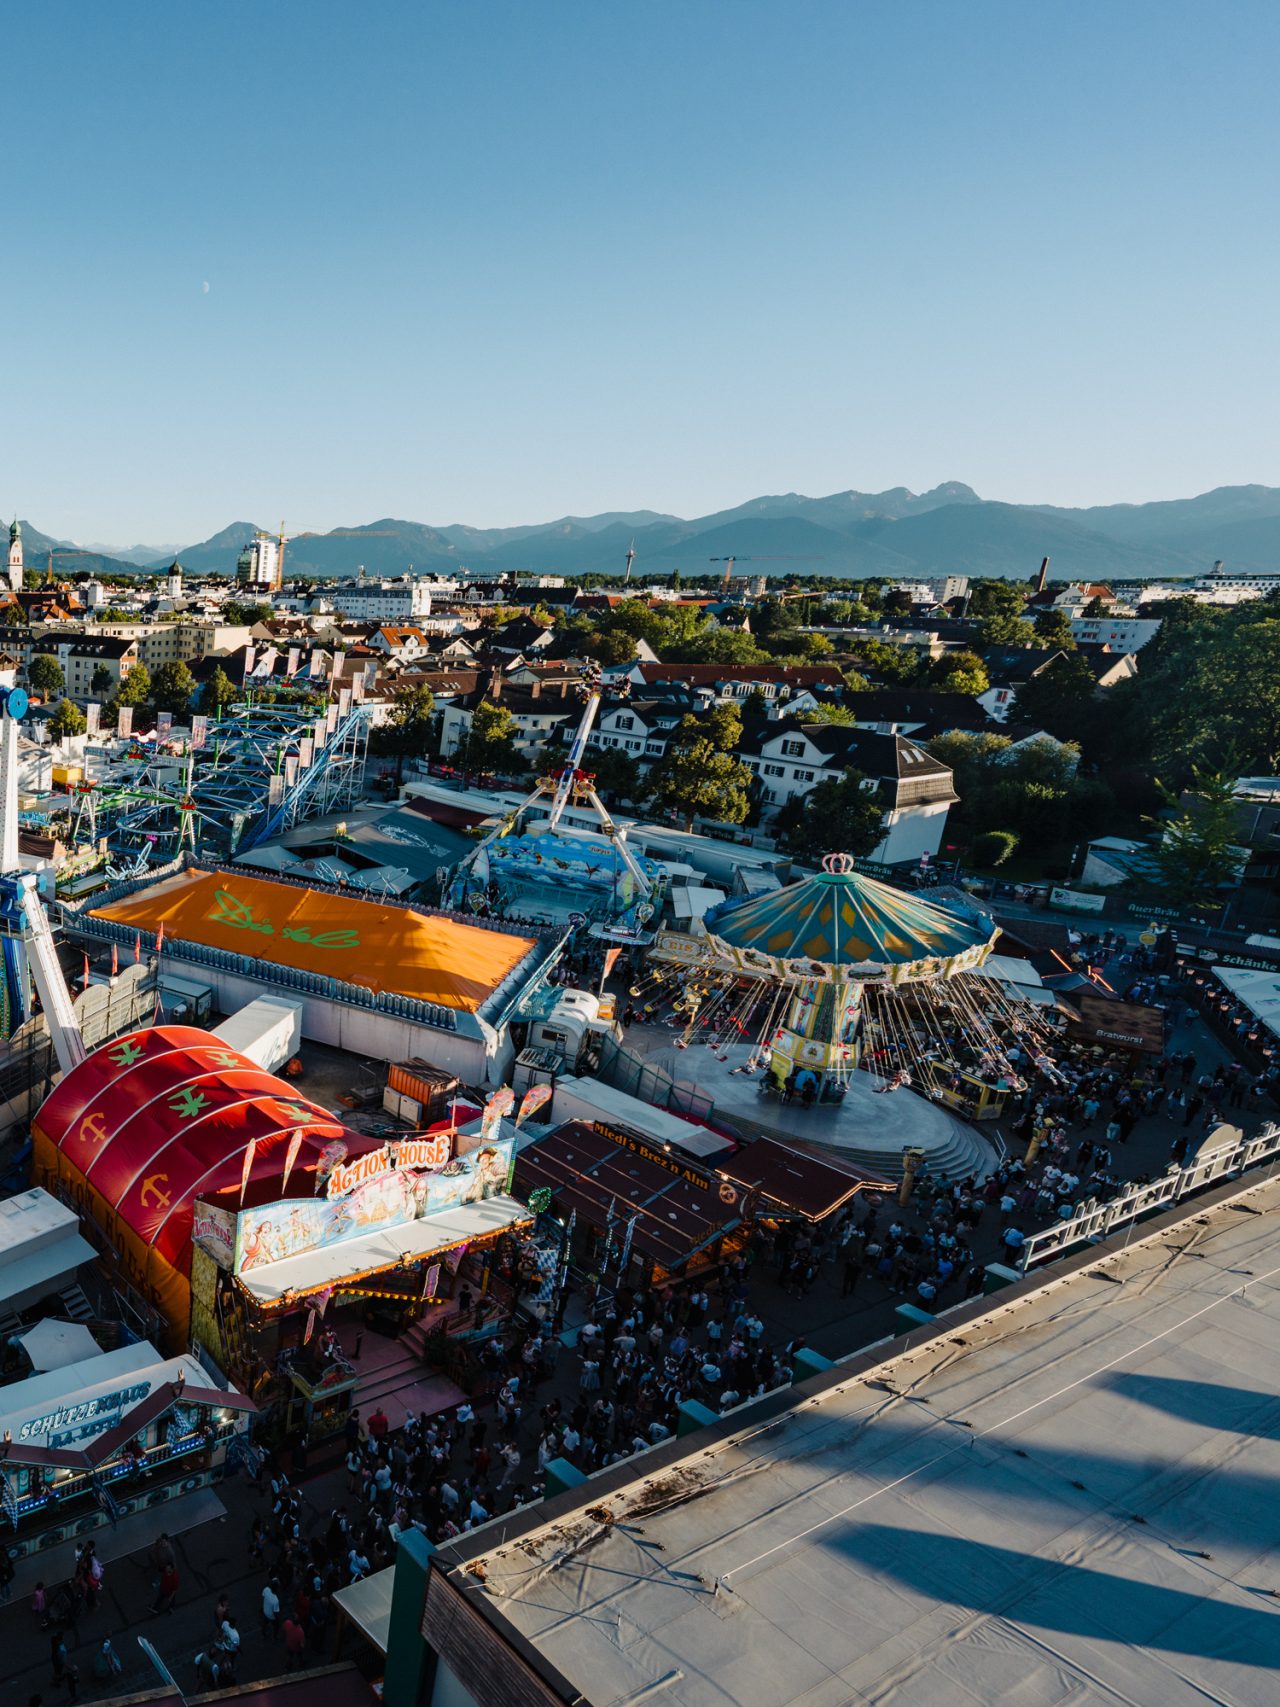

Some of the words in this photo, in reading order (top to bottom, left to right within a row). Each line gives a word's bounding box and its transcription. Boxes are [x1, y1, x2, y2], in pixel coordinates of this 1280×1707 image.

[1128, 903, 1180, 918] AuerBräu
[669, 941, 694, 953] EIS
[1222, 954, 1278, 972] Schänke
[1096, 1029, 1143, 1044] Bratwurst
[329, 1149, 389, 1197] ACTION
[397, 1138, 447, 1167] HOUSE
[682, 1170, 709, 1191] Alm
